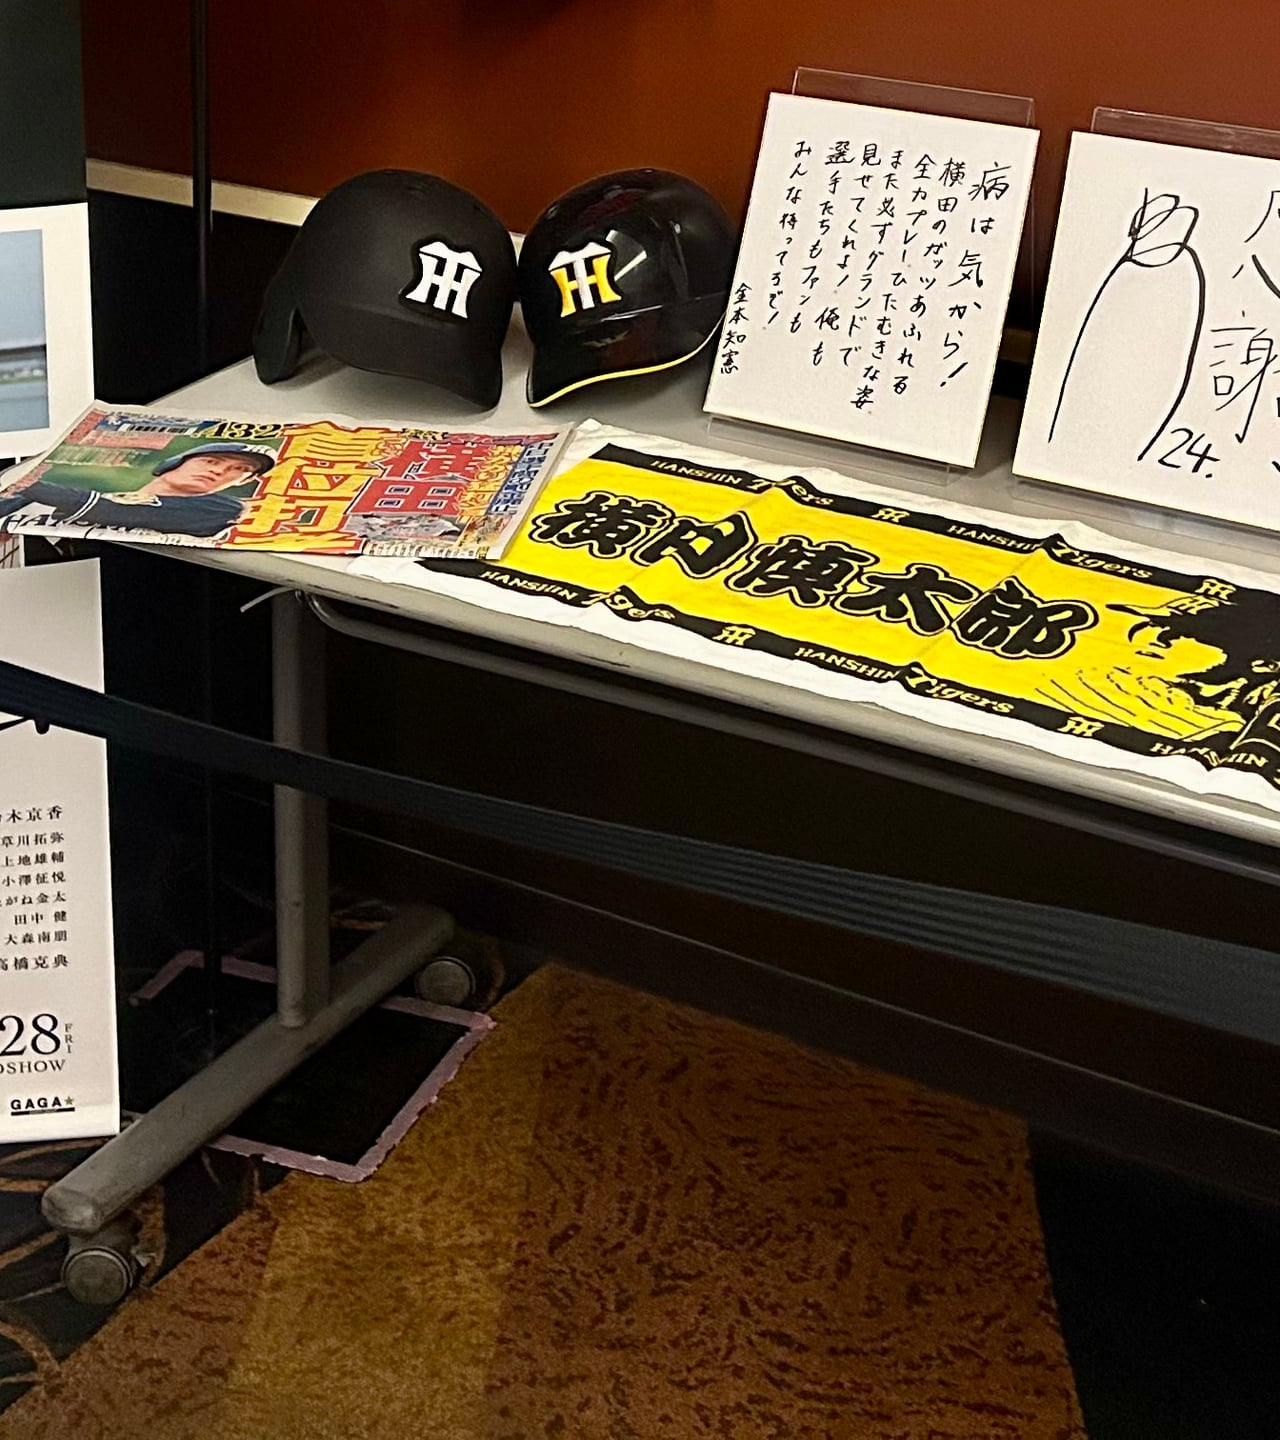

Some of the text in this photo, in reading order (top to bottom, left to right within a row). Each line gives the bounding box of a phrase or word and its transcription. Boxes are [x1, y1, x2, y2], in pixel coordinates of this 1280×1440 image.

[939, 160, 1012, 388] 病は気から！
[719, 281, 752, 375] 金本知憲
[649, 458, 743, 487] HANSHIN
[529, 491, 1099, 659] 横田慎太郎
[1051, 540, 1154, 580] Tigers
[479, 568, 578, 601] HANSHIN
[794, 645, 1016, 716] HANSHIN Tigers
[0, 831, 66, 848] 草川拓弥
[10, 1096, 63, 1111] GAGA
